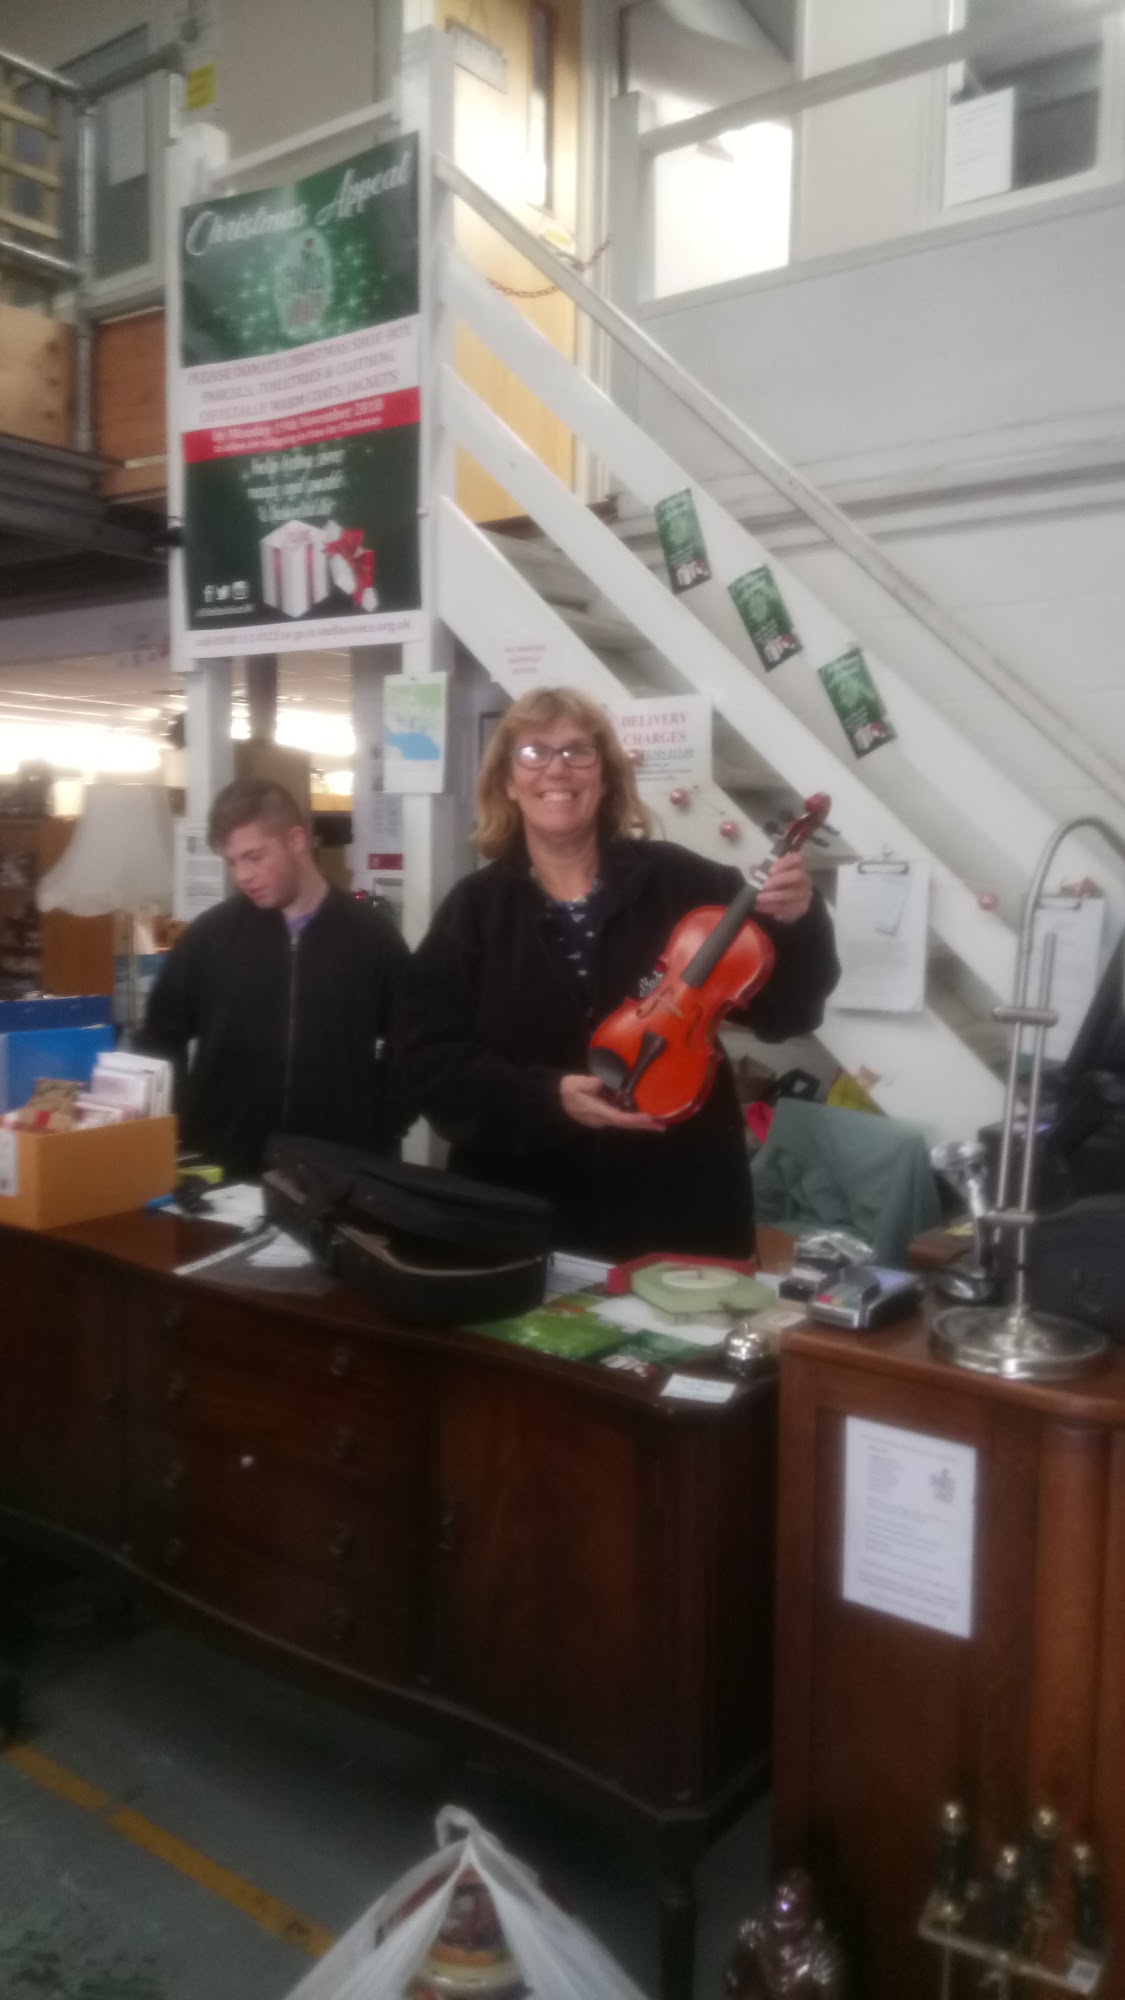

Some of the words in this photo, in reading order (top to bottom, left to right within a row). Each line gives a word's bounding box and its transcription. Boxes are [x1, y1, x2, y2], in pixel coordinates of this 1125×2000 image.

[185, 206, 307, 256] Christmas
[315, 151, 412, 226] Appeal
[354, 397, 384, 416] 2018
[621, 711, 689, 728] DELIVERY
[622, 730, 688, 746] CHARGES
